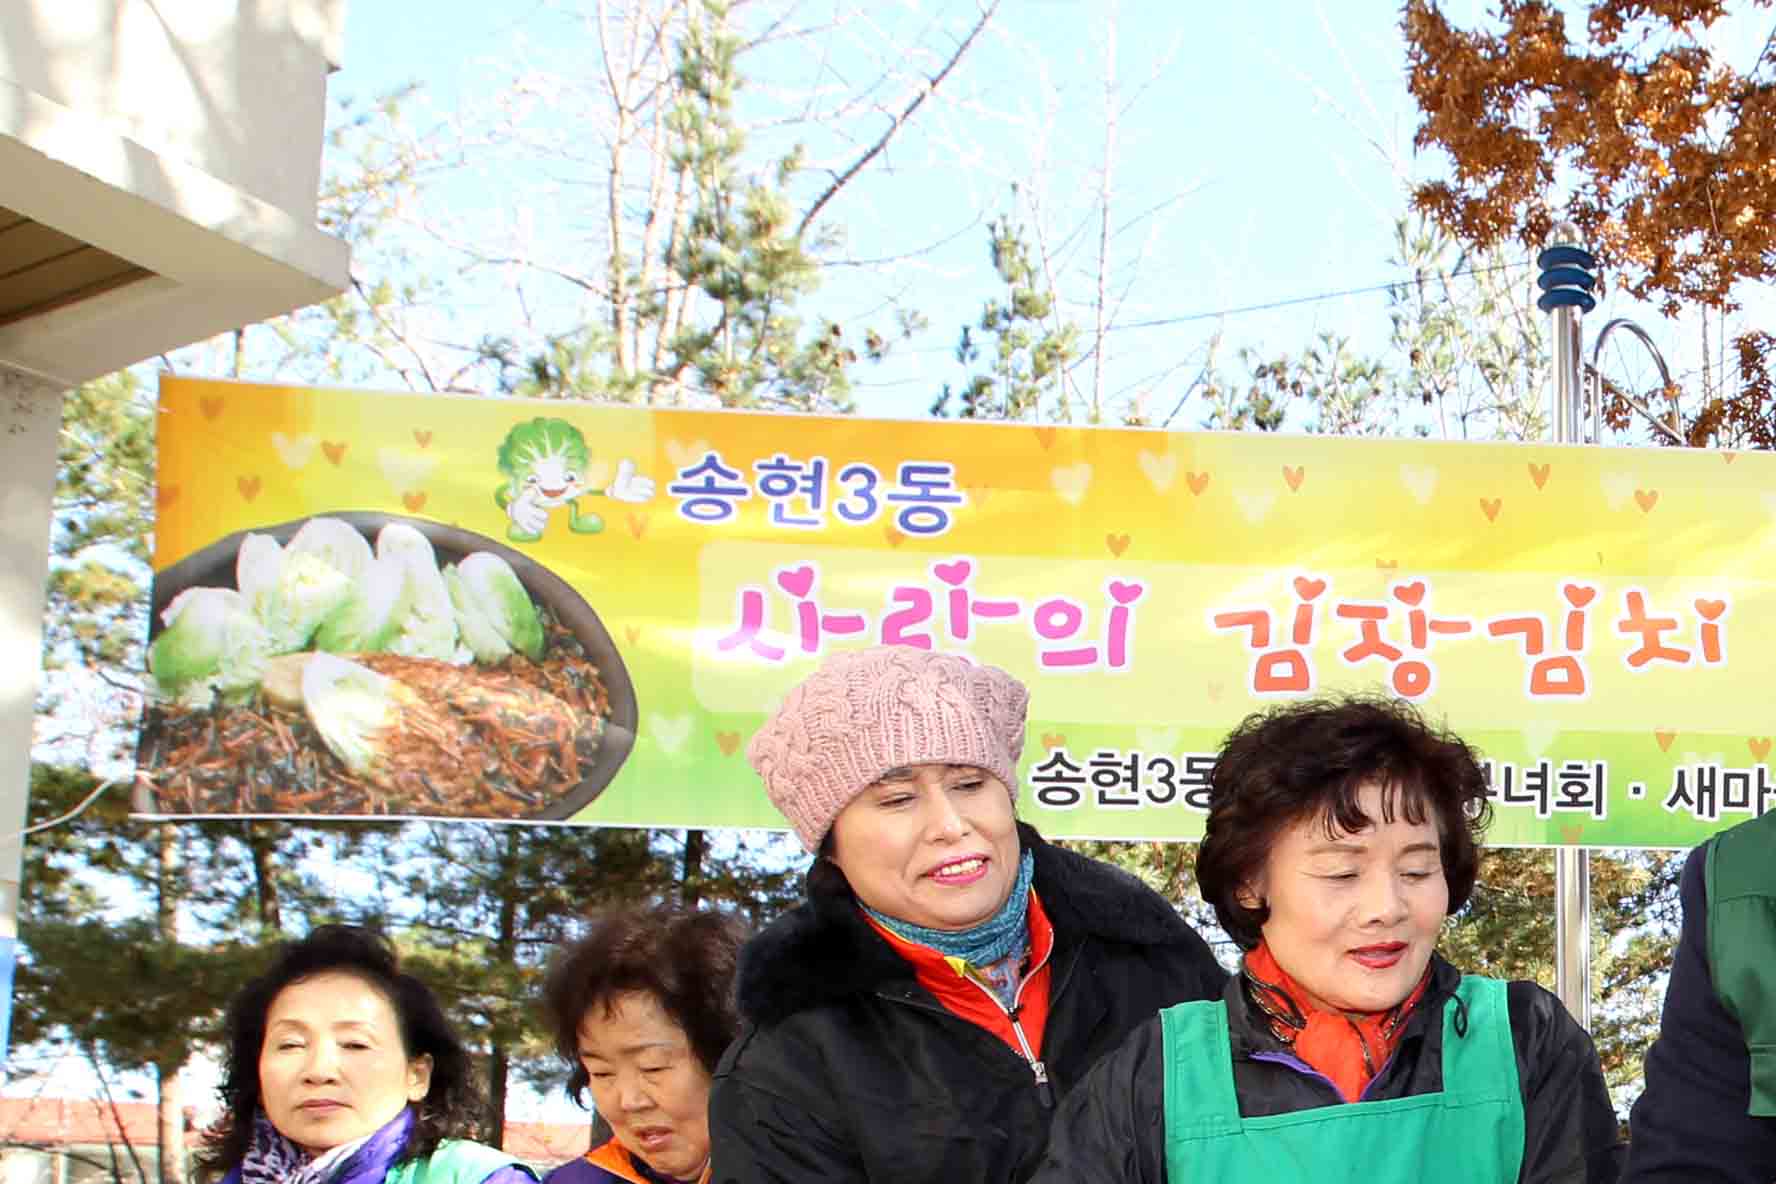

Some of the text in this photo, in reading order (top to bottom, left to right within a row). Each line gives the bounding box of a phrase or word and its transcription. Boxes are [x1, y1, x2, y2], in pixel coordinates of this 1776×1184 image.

[670, 454, 963, 534] 송현3동
[1213, 576, 1727, 698] 김장김치
[1478, 762, 1603, 816] 녀회
